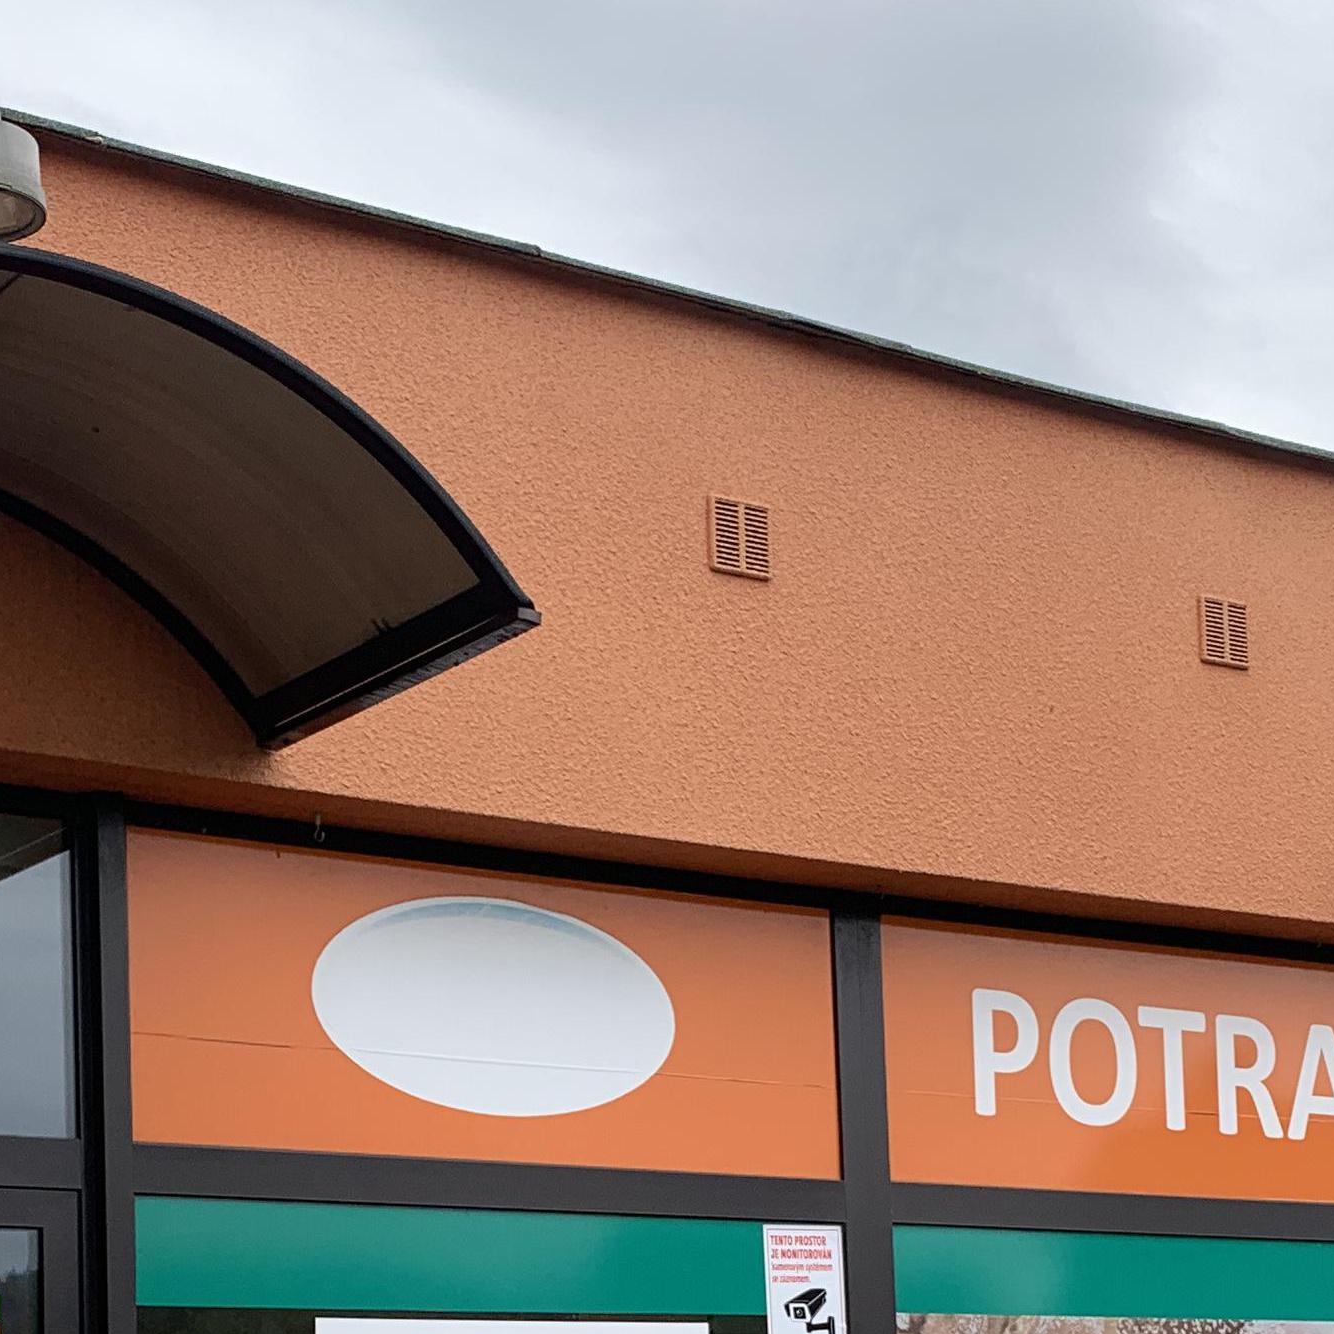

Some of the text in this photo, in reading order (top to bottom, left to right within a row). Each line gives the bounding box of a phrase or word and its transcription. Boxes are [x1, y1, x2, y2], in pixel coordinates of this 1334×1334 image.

[770, 1235, 827, 1246] TENTO PROSTOR
[771, 1248, 832, 1260] JE MONITOROVÁN
